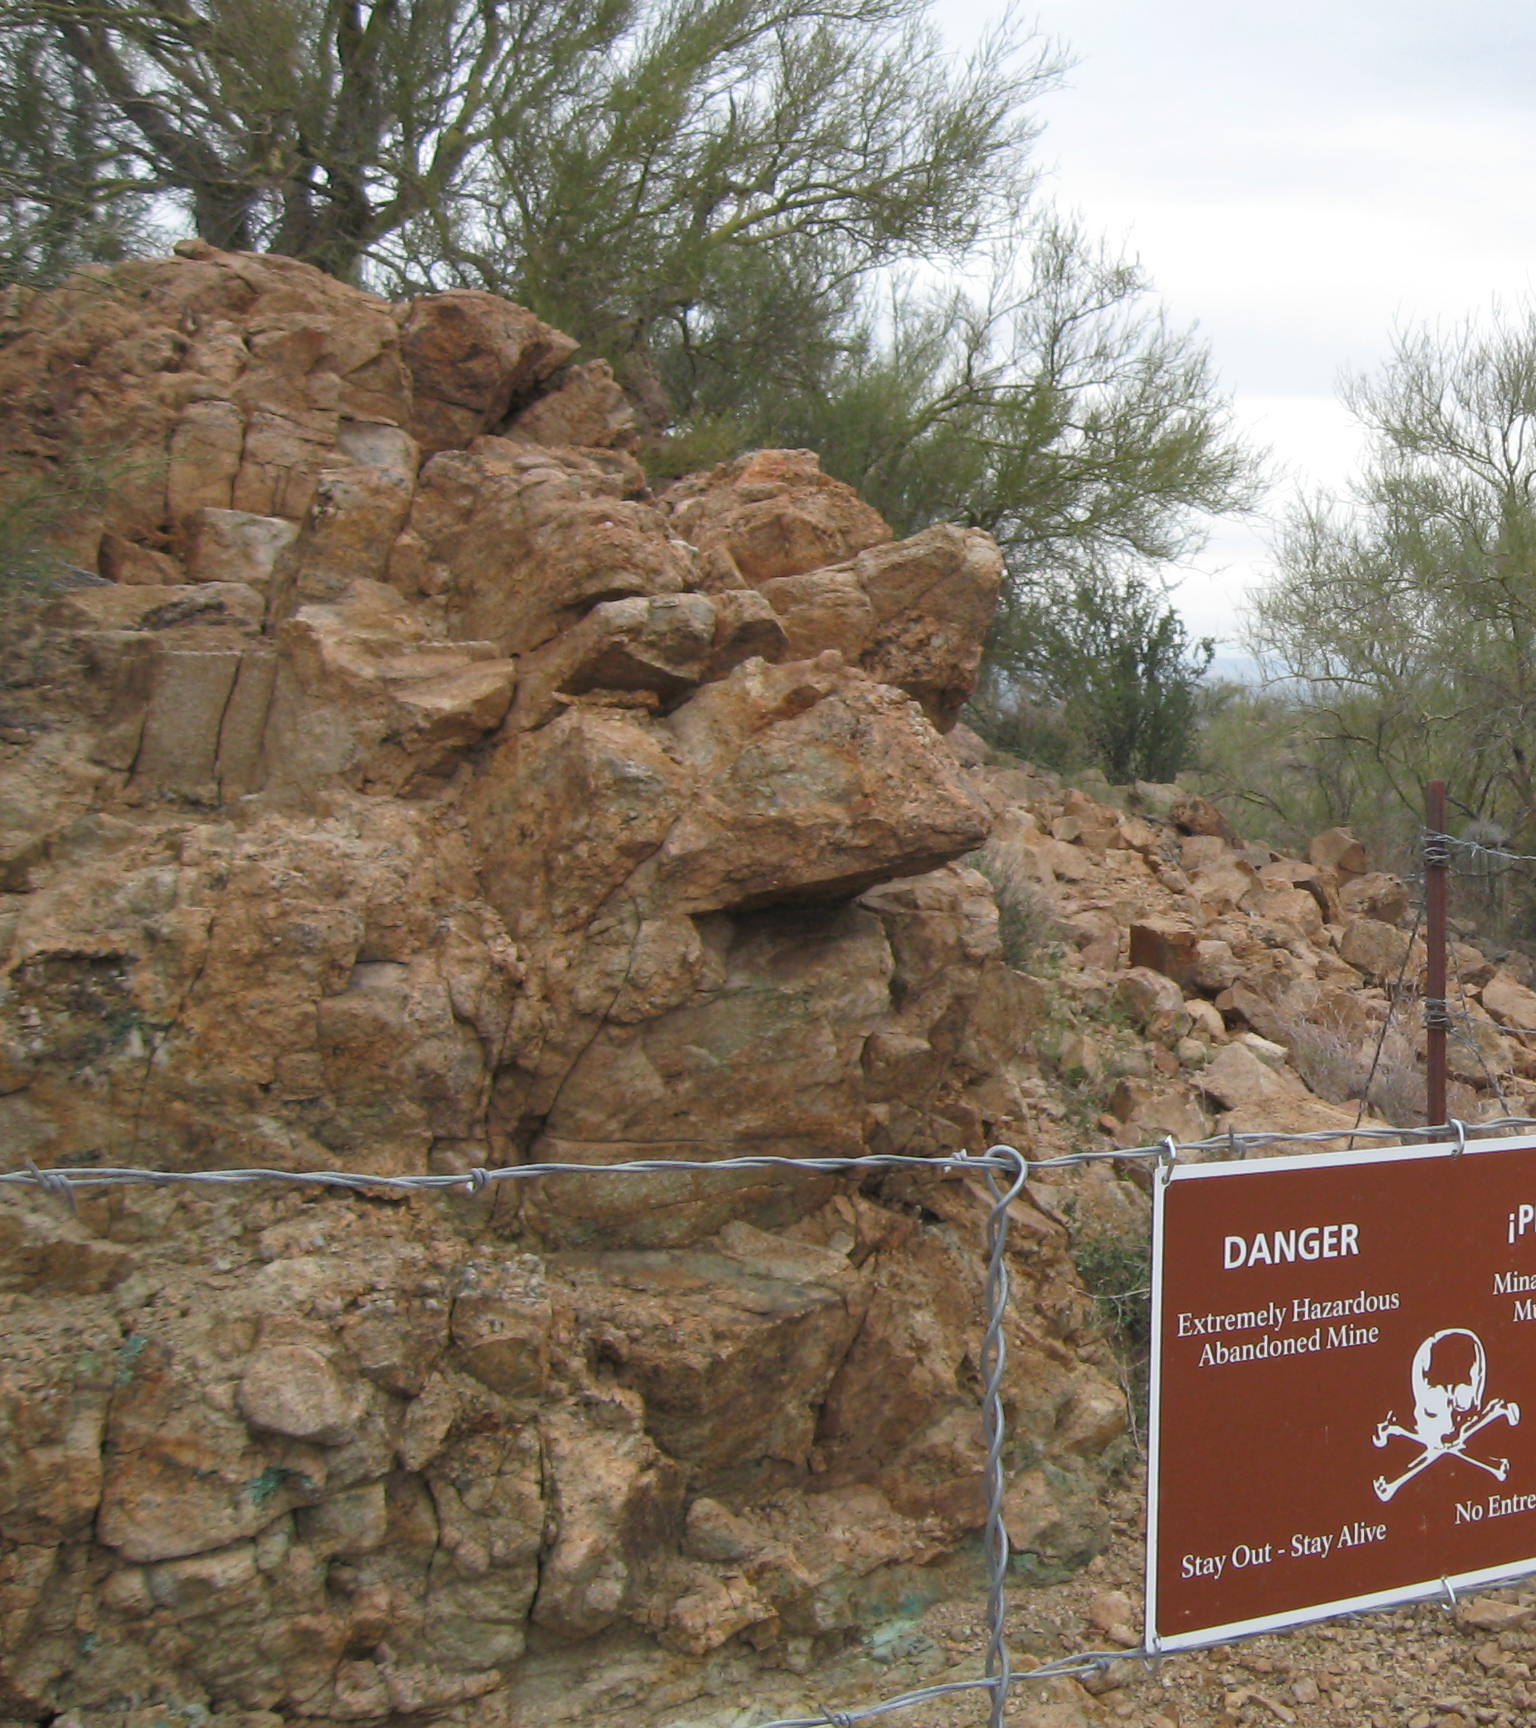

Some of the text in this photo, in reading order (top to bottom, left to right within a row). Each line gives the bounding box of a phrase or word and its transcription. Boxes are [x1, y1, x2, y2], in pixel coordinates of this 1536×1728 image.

[1224, 1224, 1359, 1269] DANGER
[1177, 1291, 1400, 1337] Extremely Hazardous
[1198, 1324, 1379, 1367] Abandoned Mine
[1454, 1501, 1484, 1525] No
[1487, 1494, 1536, 1518] Entre
[1181, 1554, 1227, 1580] Stay
[1231, 1544, 1273, 1569] Out
[1290, 1534, 1334, 1559] Stay
[1336, 1522, 1387, 1549] Alive
